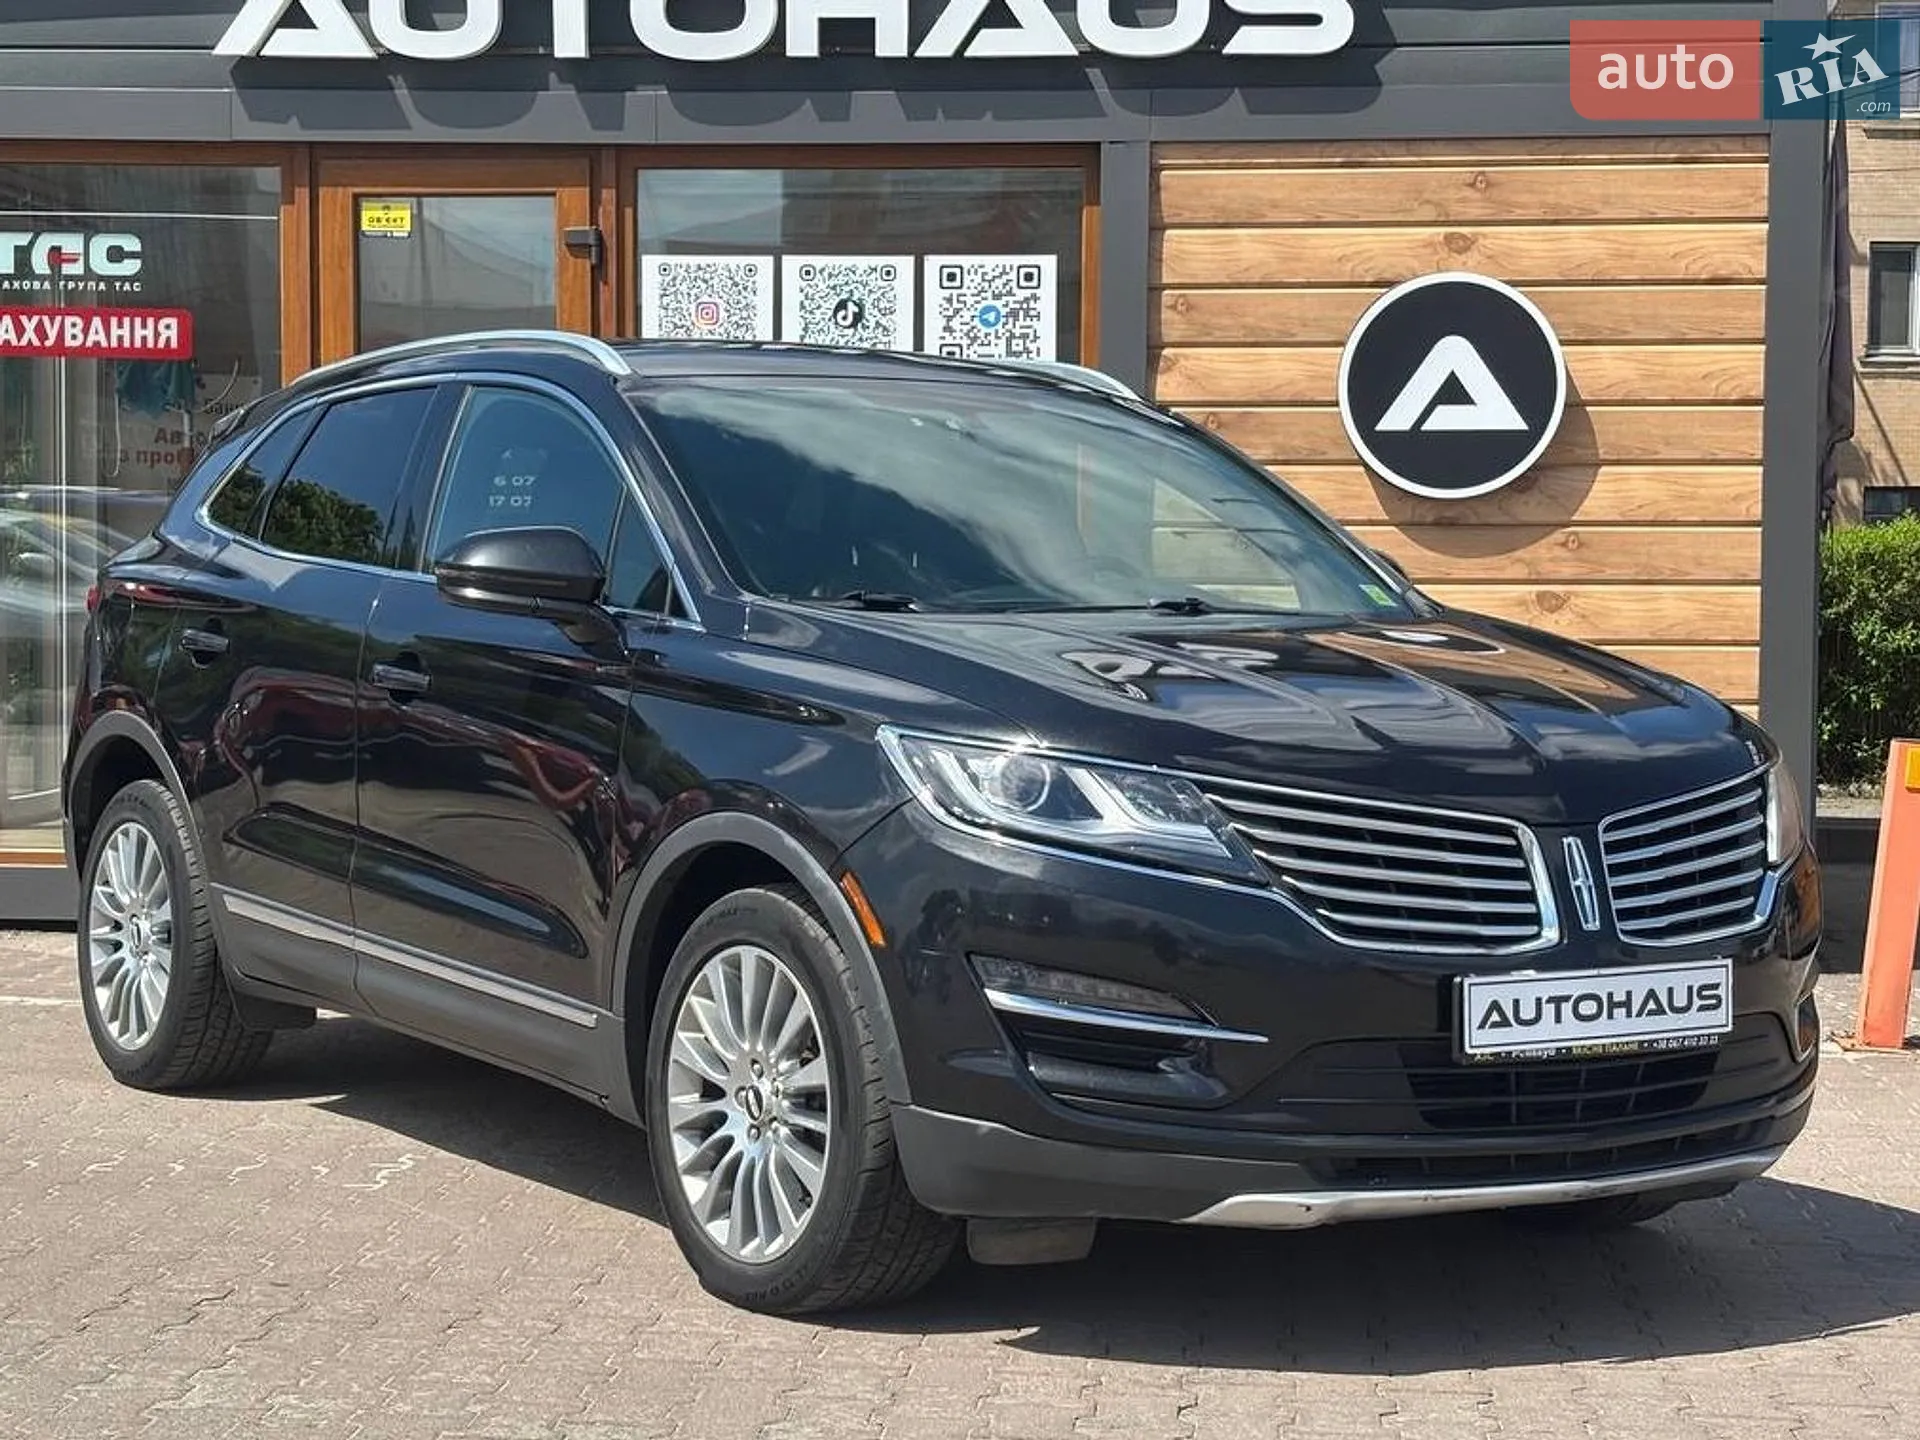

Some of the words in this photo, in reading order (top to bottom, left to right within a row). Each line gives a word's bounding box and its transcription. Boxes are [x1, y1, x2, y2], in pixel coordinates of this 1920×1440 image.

[212, 0, 1354, 60] AUTOHAUS
[59, 280, 106, 291] ГРУПА
[115, 281, 142, 292] ТАС
[0, 314, 178, 348] АХУВАННЯ
[1476, 982, 1723, 1031] AUTOHAUS
